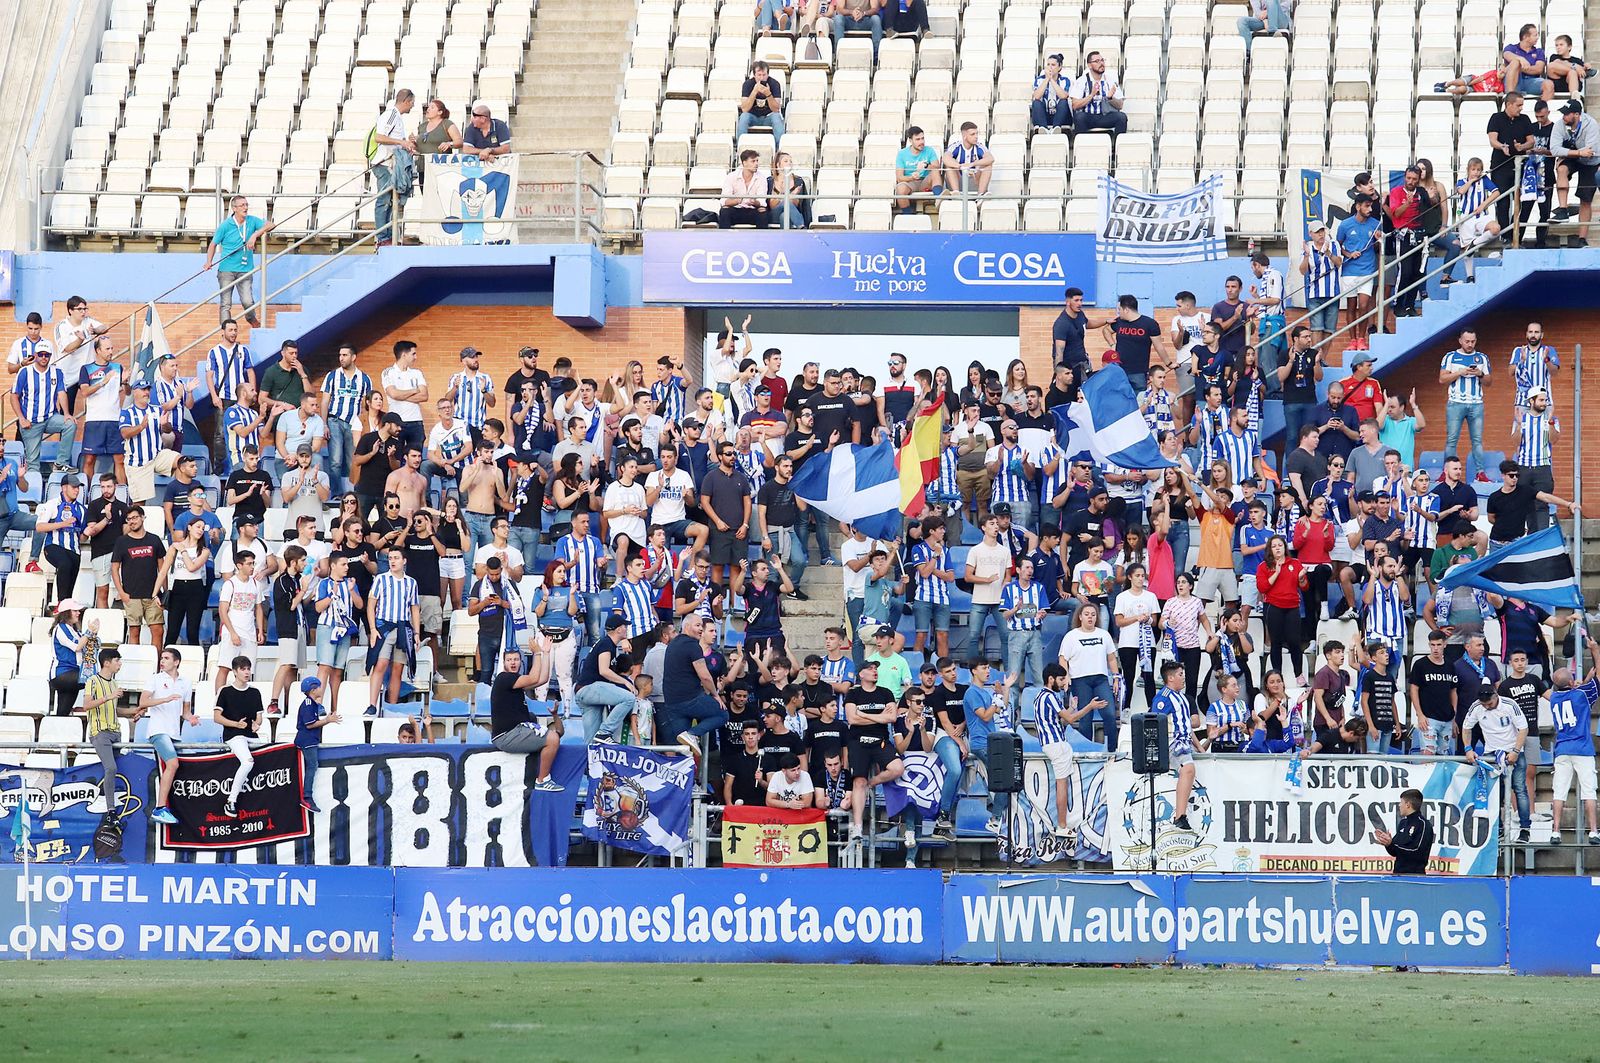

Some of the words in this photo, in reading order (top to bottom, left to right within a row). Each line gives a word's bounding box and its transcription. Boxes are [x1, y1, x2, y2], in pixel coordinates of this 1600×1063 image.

[681, 249, 792, 284] CEOSA
[832, 248, 926, 279] Huelva
[953, 250, 1066, 285] CEOSA
[854, 279, 881, 292] me
[888, 279, 927, 296] pone
[1119, 327, 1146, 336] HUGO
[1552, 700, 1577, 730] 14
[1307, 765, 1409, 789] SECTOR
[52, 789, 94, 802] ONUBA
[209, 825, 232, 837] 1985
[241, 821, 264, 833] 2010
[1267, 859, 1319, 871] DECANO
[1323, 860, 1347, 872] DEL
[1352, 857, 1395, 872] FÚTBO
[16, 875, 149, 903] HOTEL
[162, 872, 317, 906] MARTÍN
[412, 891, 924, 944] Atraccioneslacinta.com
